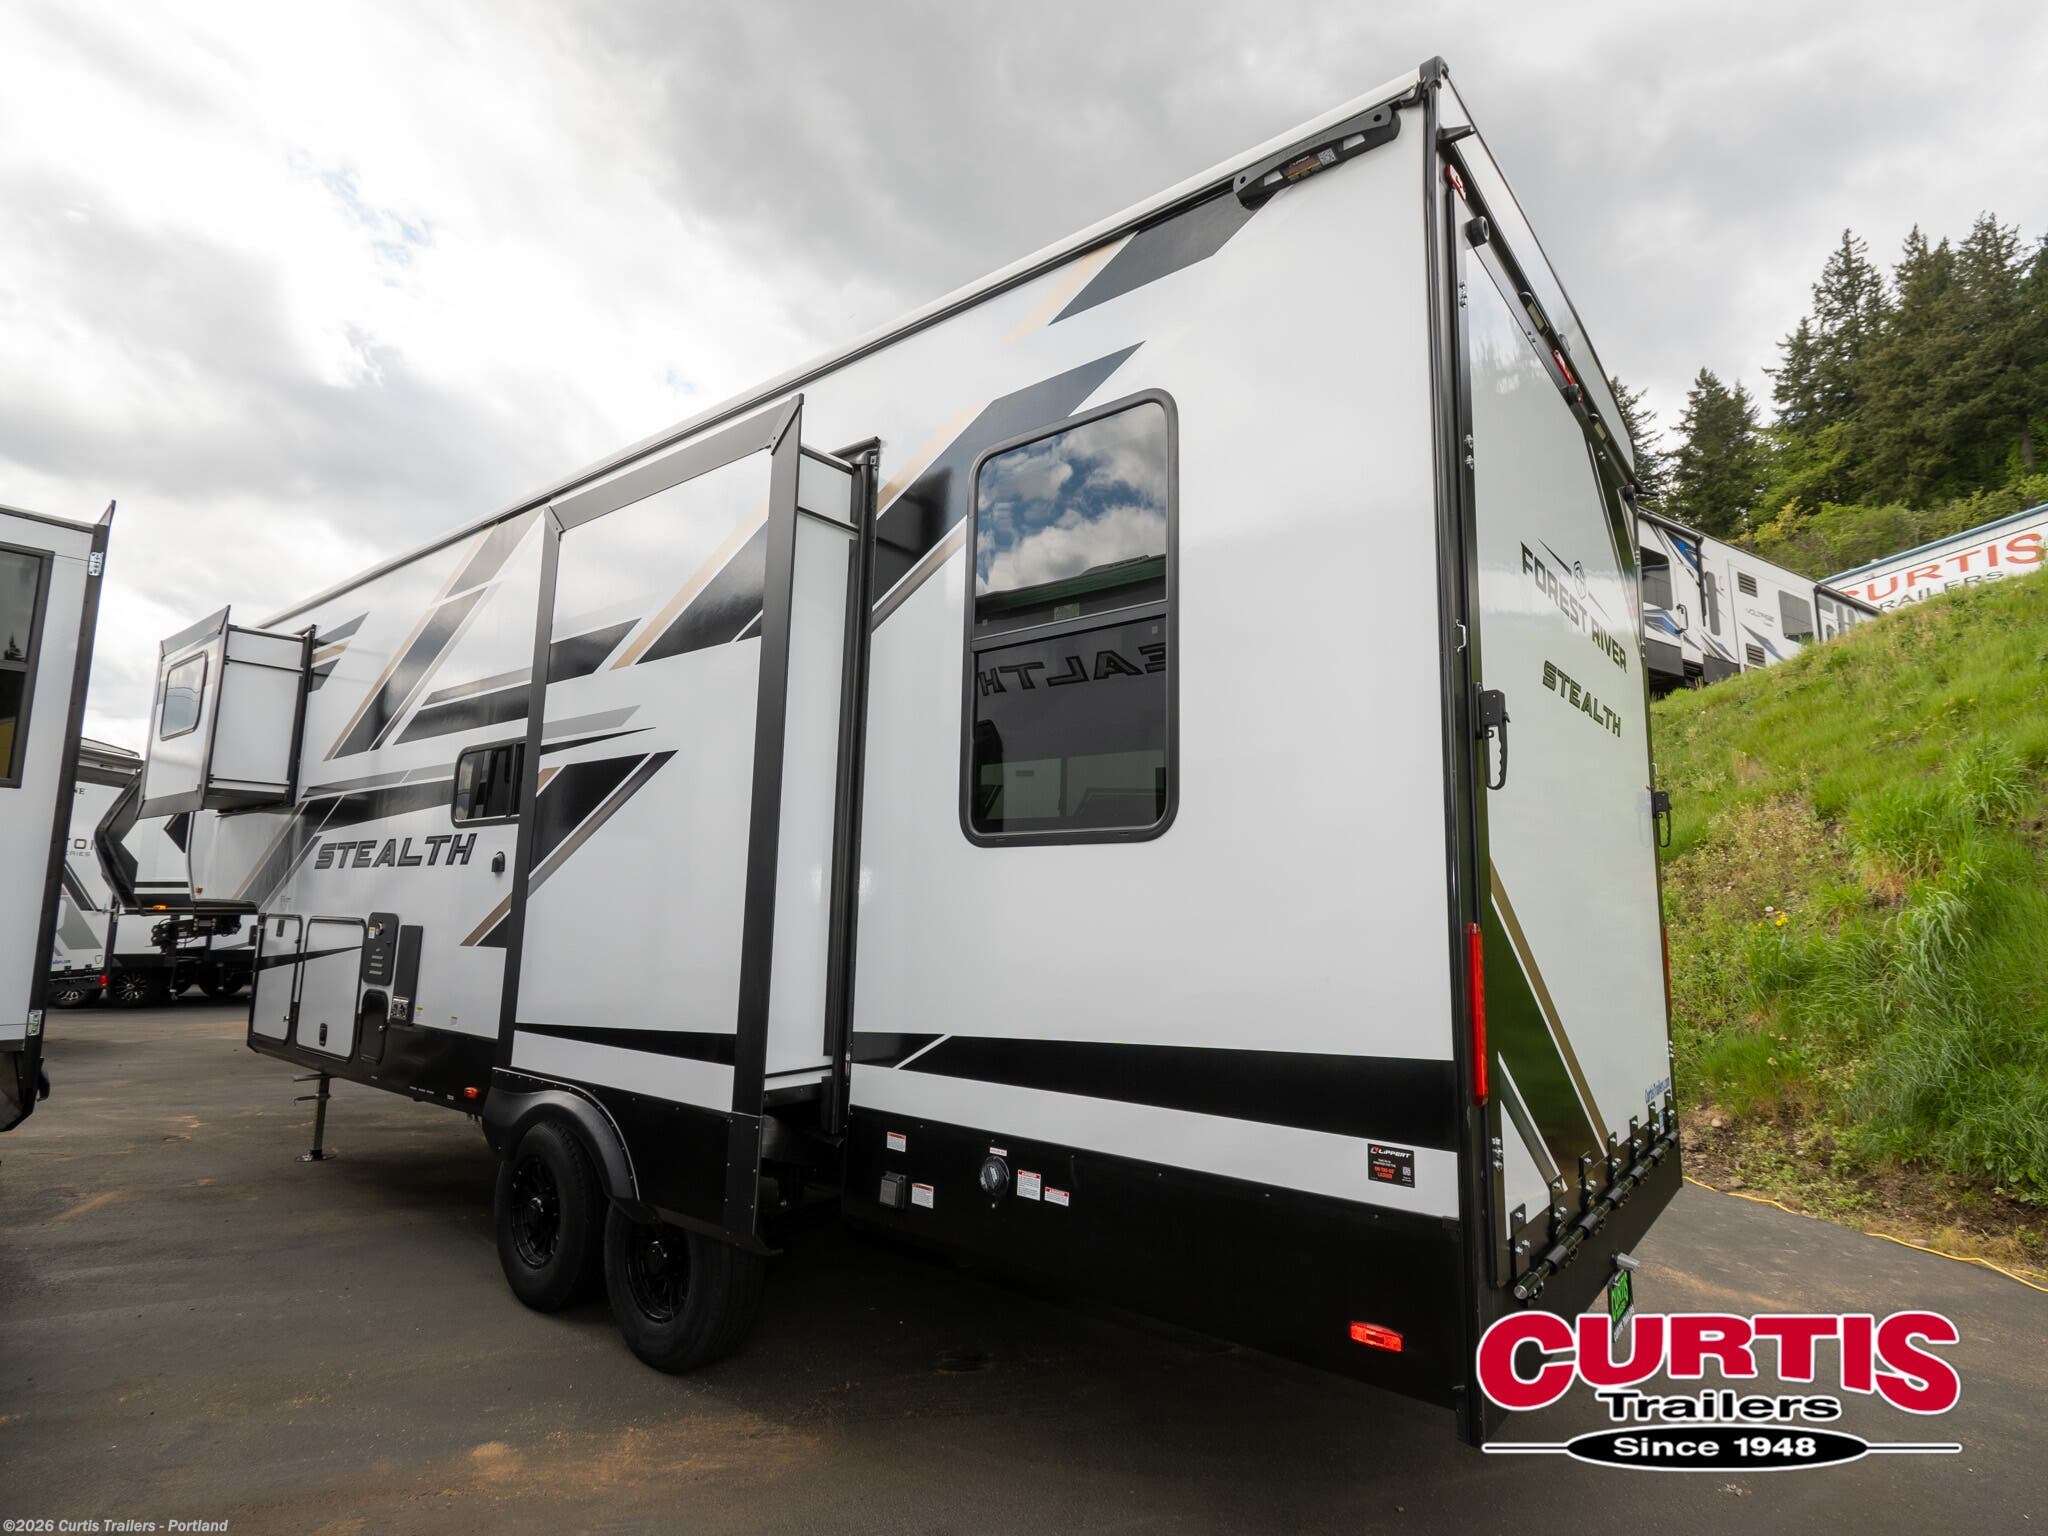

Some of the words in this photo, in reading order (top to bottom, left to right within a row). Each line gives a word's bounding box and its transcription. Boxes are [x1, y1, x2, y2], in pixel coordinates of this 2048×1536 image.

[1843, 533, 2043, 601] URTIS
[1520, 541, 1588, 633] FOREST
[1591, 616, 1628, 674] RIVER
[1542, 659, 1622, 738] STEALTH
[314, 832, 478, 870] STEALTH
[1378, 1148, 1412, 1159] LIPPERT
